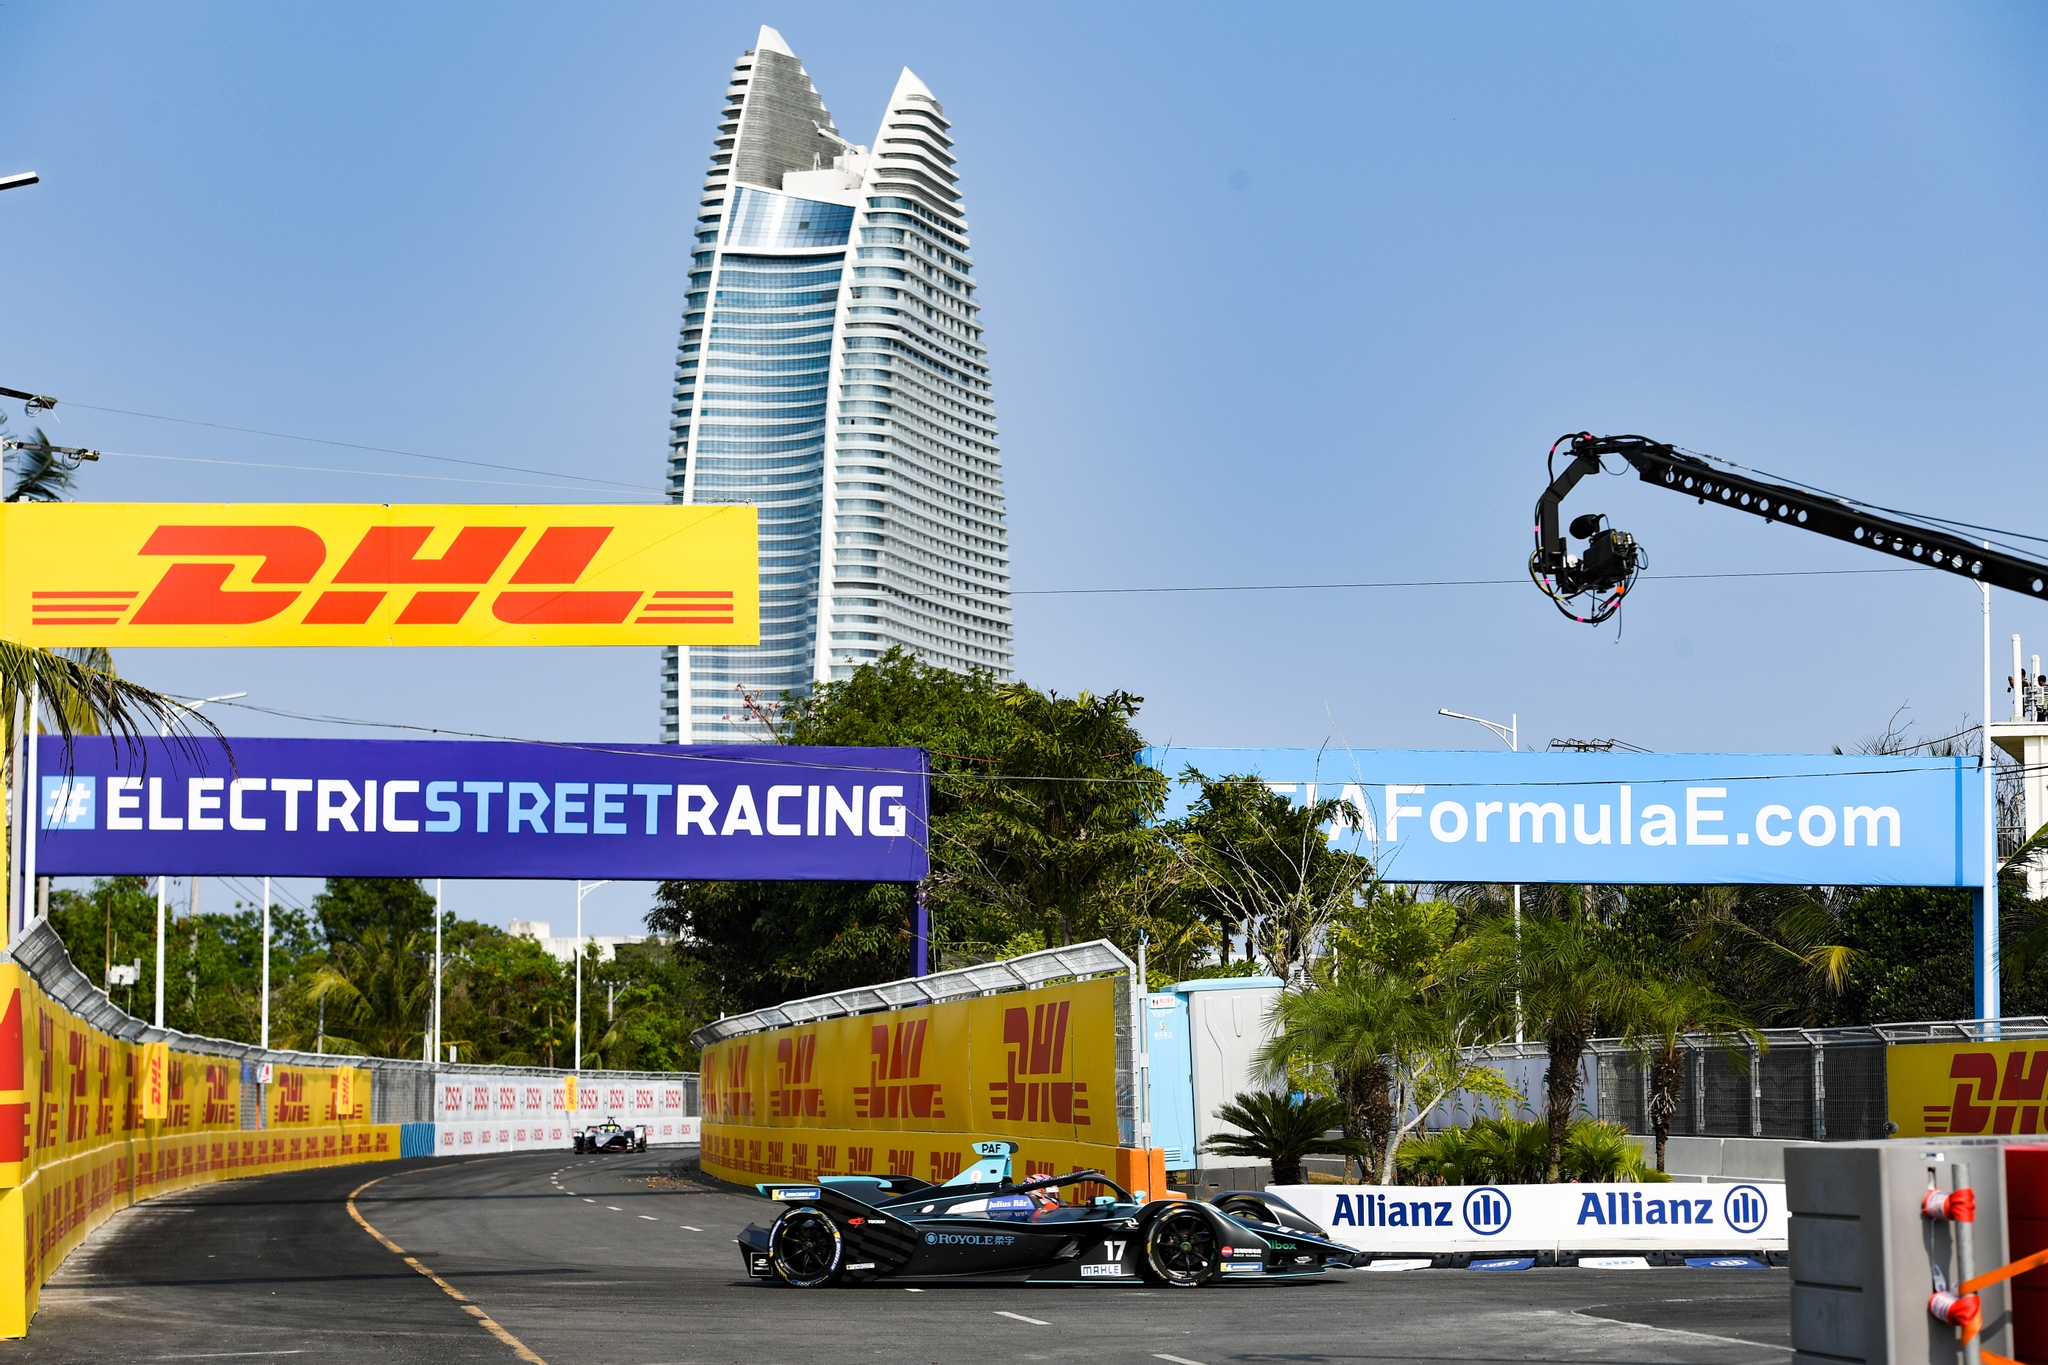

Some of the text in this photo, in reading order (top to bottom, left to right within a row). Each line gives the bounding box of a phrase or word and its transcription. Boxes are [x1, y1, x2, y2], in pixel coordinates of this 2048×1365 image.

[128, 525, 645, 625] DHL
[44, 776, 907, 837] #ELECTRICSTREETRACING
[151, 1056, 161, 1105] DHL
[777, 1034, 819, 1117] DHL
[871, 1019, 935, 1118] DHL
[1003, 1001, 1076, 1124] DHL
[204, 1064, 229, 1124] DHL
[278, 1072, 304, 1122] DHL
[1949, 1051, 2048, 1134] DH
[981, 1143, 1002, 1154] PAF
[988, 1199, 1029, 1210] Julius Bär
[1332, 1194, 1454, 1227] Allianz
[1577, 1192, 1714, 1225] Allianz
[938, 1235, 1015, 1246] ROYOLE 柔宇
[1104, 1240, 1127, 1262] 17
[1082, 1265, 1121, 1276] MAHLE
